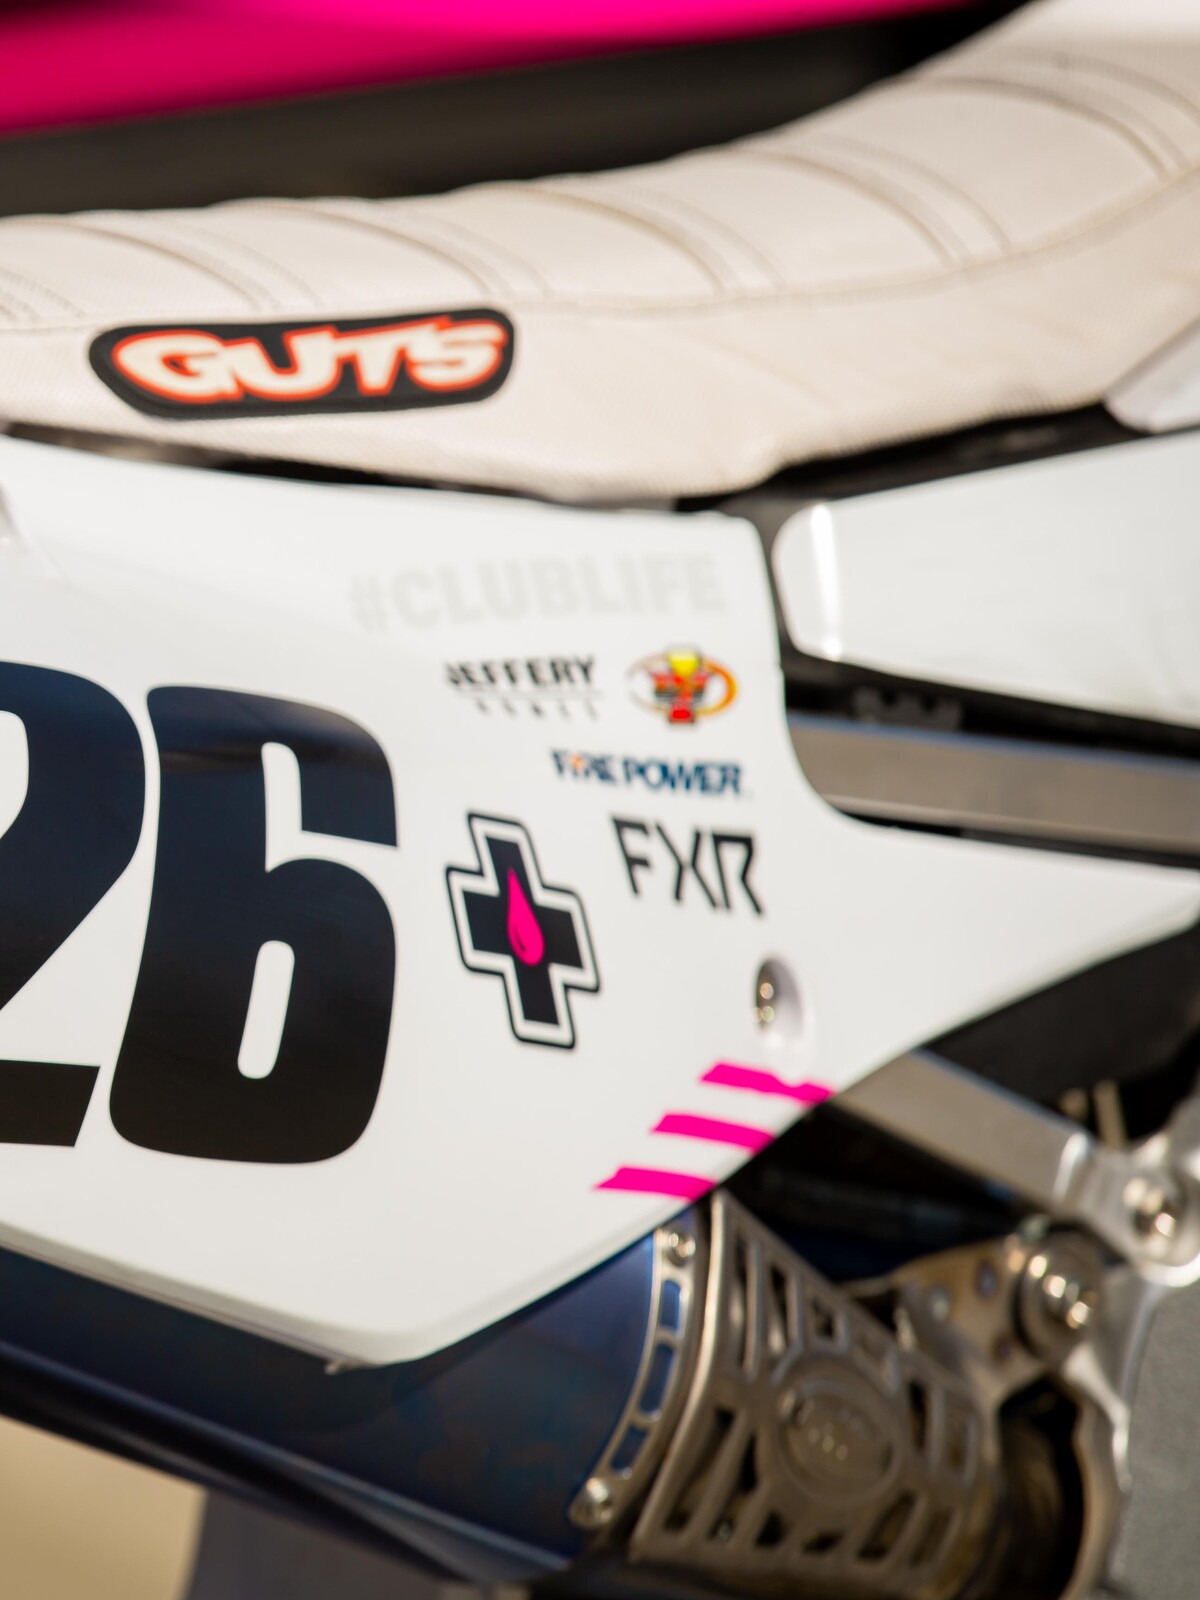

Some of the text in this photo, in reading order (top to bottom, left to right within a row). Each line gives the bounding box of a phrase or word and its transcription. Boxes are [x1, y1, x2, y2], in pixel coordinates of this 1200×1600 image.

[112, 315, 507, 404] GUTS
[348, 553, 728, 635] #CLUBLIFE
[445, 655, 595, 687] JEFFERY
[622, 757, 741, 796] POWER
[610, 812, 764, 916] FXR
